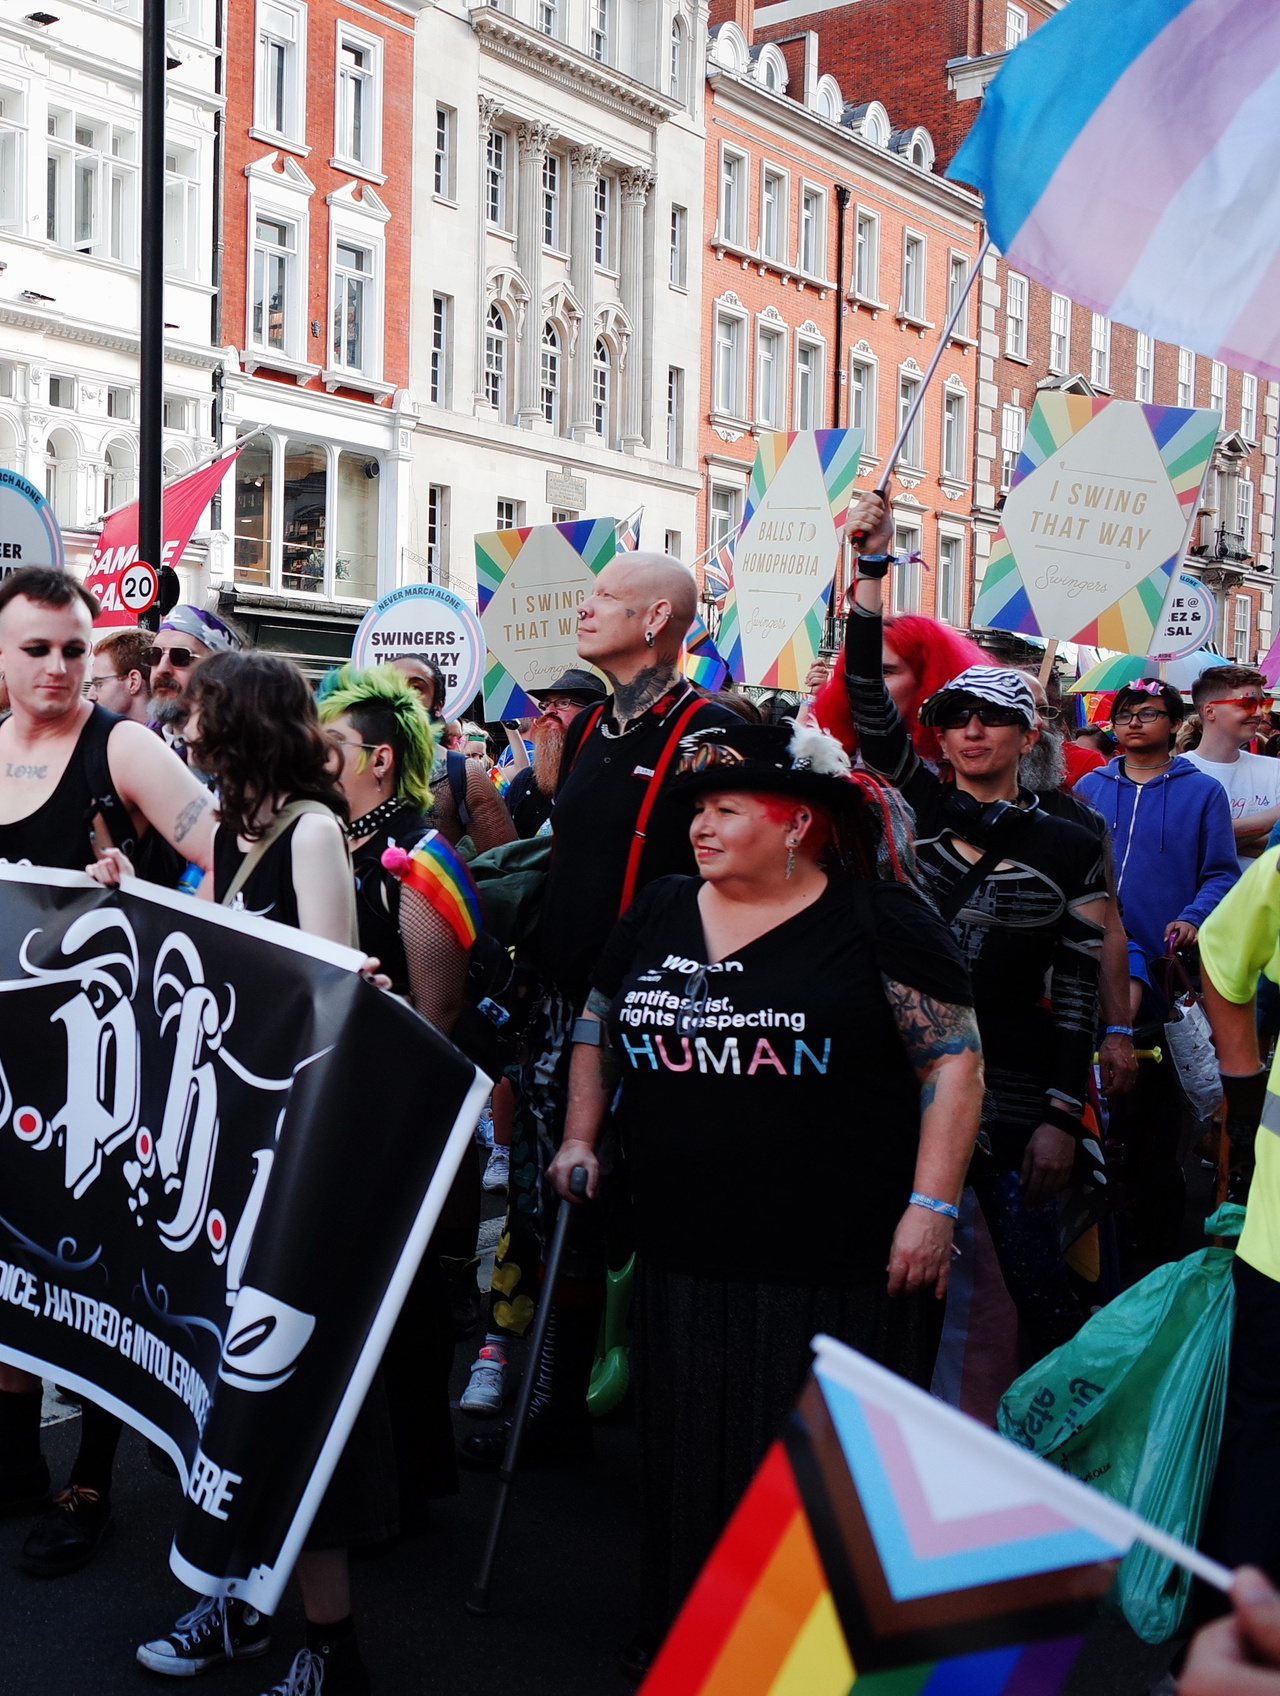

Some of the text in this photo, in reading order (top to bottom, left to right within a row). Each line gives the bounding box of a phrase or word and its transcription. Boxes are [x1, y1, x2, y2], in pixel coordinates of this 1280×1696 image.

[15, 479, 41, 504] ALONE
[1049, 480, 1148, 515] I SWING
[758, 521, 794, 541] BALLS
[1030, 510, 1152, 550] THAT WAY
[742, 553, 819, 576] HOMOPHOBIA
[125, 577, 151, 597] 20
[1035, 564, 1108, 598] Swingers
[378, 587, 461, 611] NEVER MARCH ALONE
[512, 589, 585, 615] I SWING
[503, 620, 549, 642] THAT
[745, 607, 786, 639] Swingers
[1164, 626, 1192, 636] SAL
[371, 631, 455, 645] SWINGERS
[623, 988, 734, 1014] antifascist,
[620, 1004, 806, 1032] rights respecting
[621, 1033, 831, 1076] HUMAN
[43, 1281, 121, 1348] HATRED
